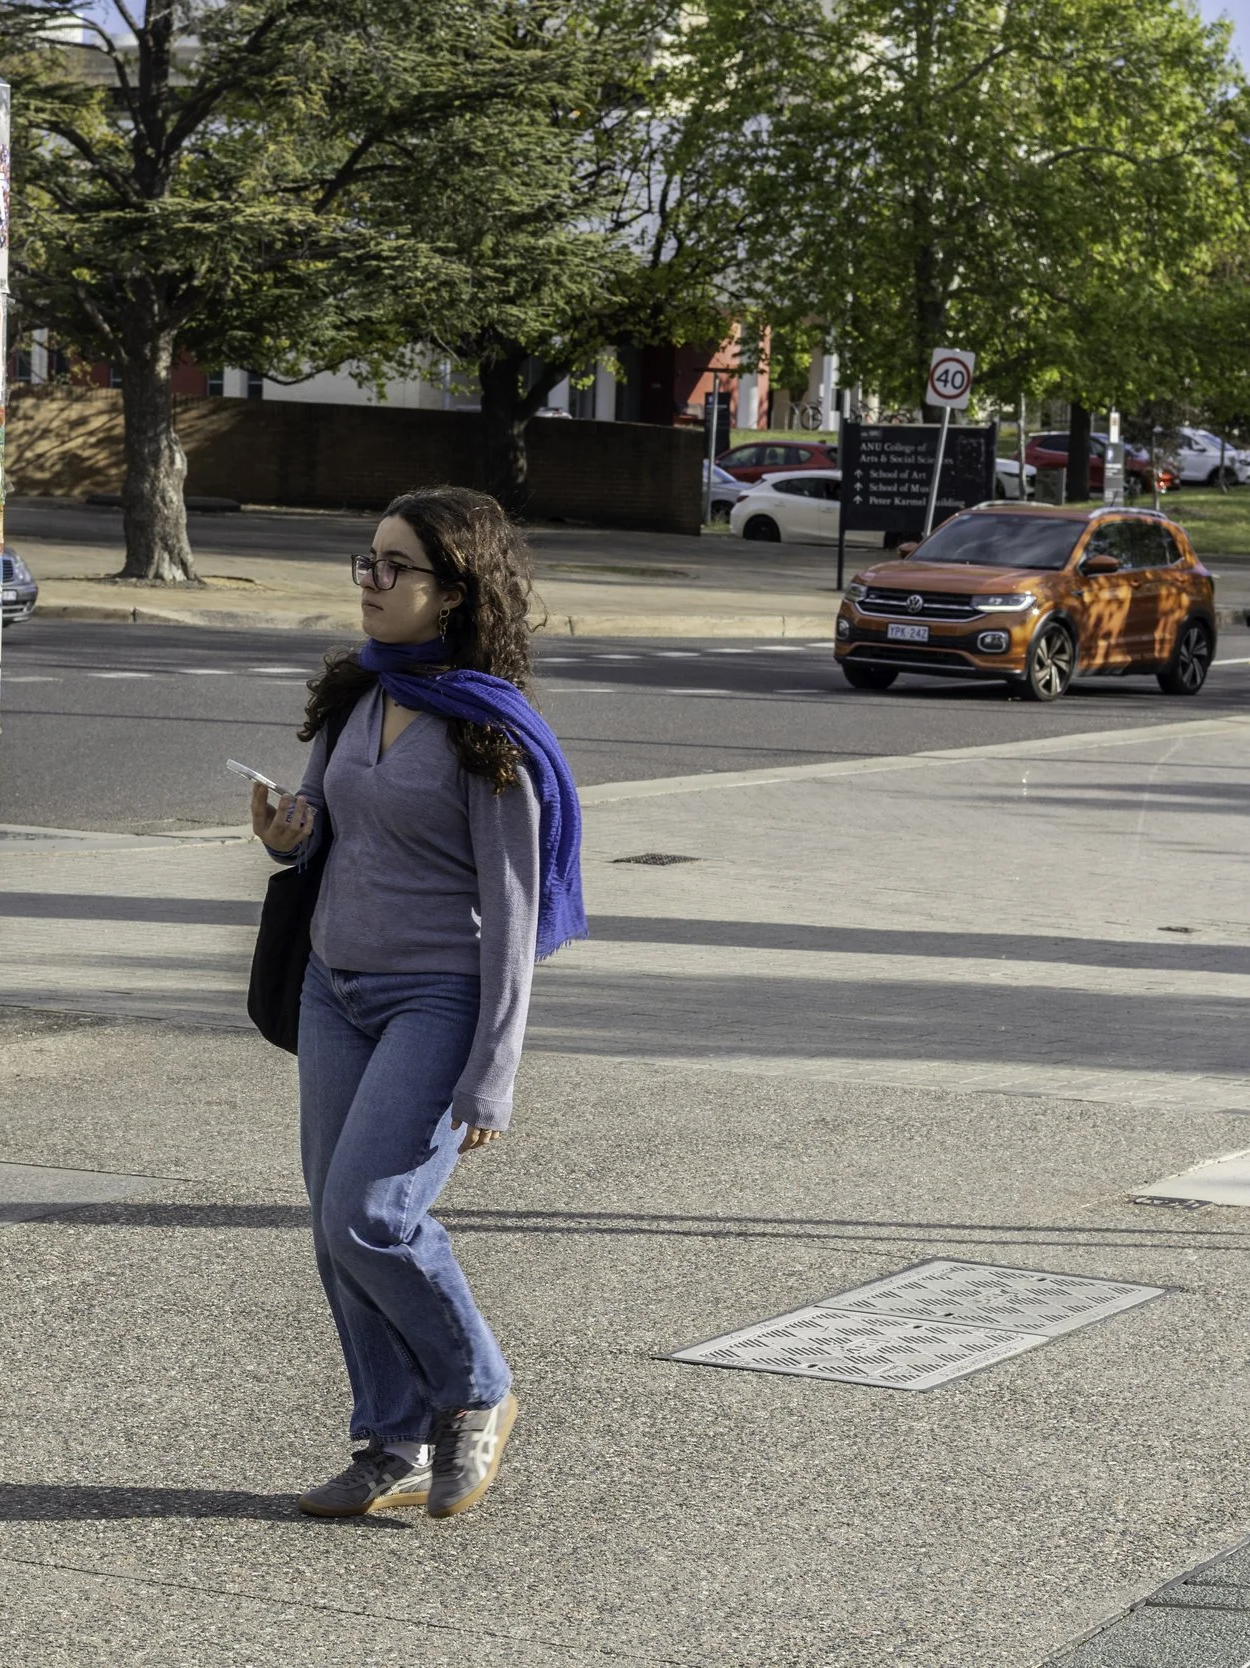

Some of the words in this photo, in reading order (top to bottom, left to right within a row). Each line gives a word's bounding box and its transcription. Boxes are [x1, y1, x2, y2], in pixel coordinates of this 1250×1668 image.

[934, 368, 966, 390] 40
[859, 442, 883, 452] ANU
[883, 442, 916, 454] College
[917, 443, 927, 452] of
[859, 454, 879, 463] Arts
[889, 454, 916, 464] Social
[869, 469, 898, 479] School
[899, 469, 910, 479] of
[911, 470, 927, 480] Art
[869, 482, 898, 492] School
[898, 482, 910, 492] of
[910, 483, 930, 493] Mus
[869, 496, 891, 505] Peter
[893, 496, 927, 507] Karmel
[934, 498, 966, 509] uilding
